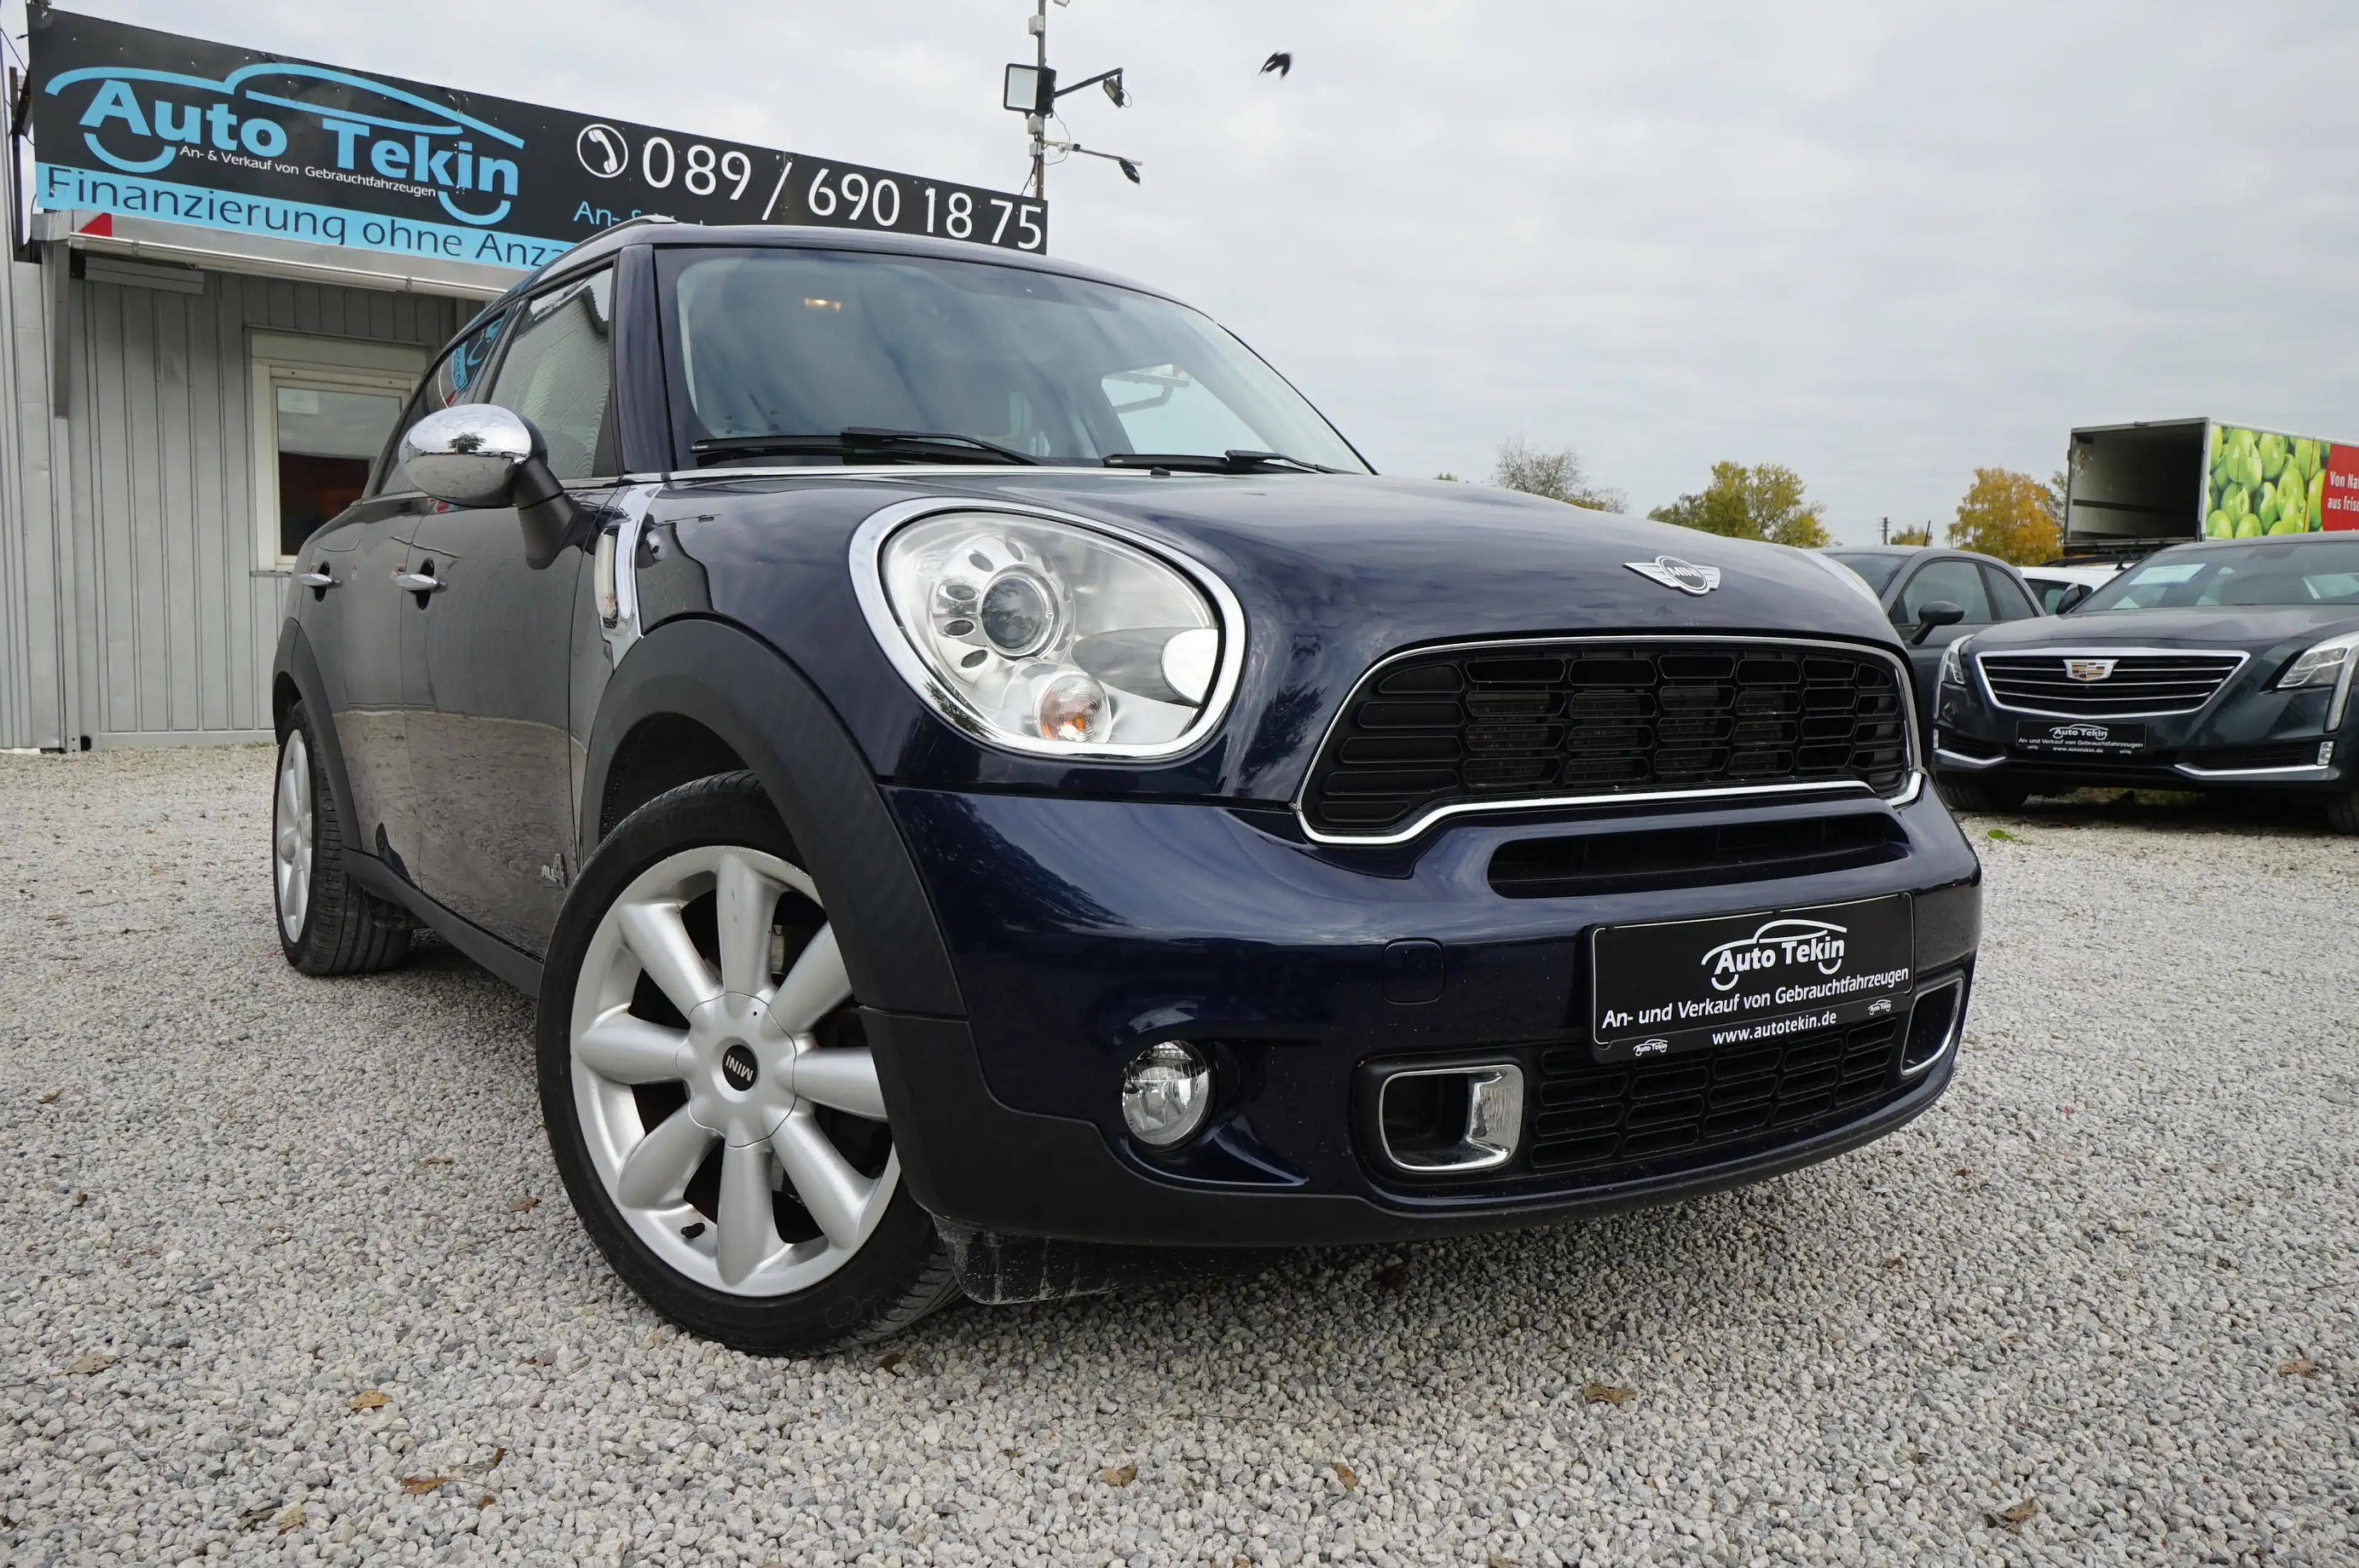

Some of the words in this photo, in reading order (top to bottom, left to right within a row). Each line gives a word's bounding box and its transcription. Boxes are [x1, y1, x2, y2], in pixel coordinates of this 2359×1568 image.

[79, 79, 287, 157] Auto
[323, 117, 518, 195] Tekin
[179, 145, 204, 158] An-
[208, 150, 217, 161] &
[221, 152, 272, 170] Verkauf
[275, 163, 299, 175] von
[305, 166, 436, 197] Gebrauchtfahrzeugen
[49, 167, 345, 245] Finanzierung
[363, 219, 462, 255] ohne
[643, 137, 751, 200] 089
[762, 162, 792, 220] /
[808, 168, 900, 226] 690
[926, 188, 972, 238] 18
[991, 199, 1042, 249] 75
[574, 201, 620, 227] An-
[2330, 470, 2345, 487] Von
[2347, 473, 2359, 490] Na
[2327, 497, 2341, 510] aus
[1666, 566, 1701, 578] MINI
[1715, 948, 1775, 975] Auto
[1782, 936, 1845, 965] Tekin
[1602, 1008, 1633, 1029] An-
[1638, 1003, 1673, 1024] und
[1678, 994, 1740, 1020] Verkauf
[1743, 993, 1770, 1009] von
[1775, 967, 1909, 1005] Gebrauchtfahrzeugen
[1713, 1010, 1837, 1045] www.autotekin.de
[726, 1055, 754, 1082] MINI
